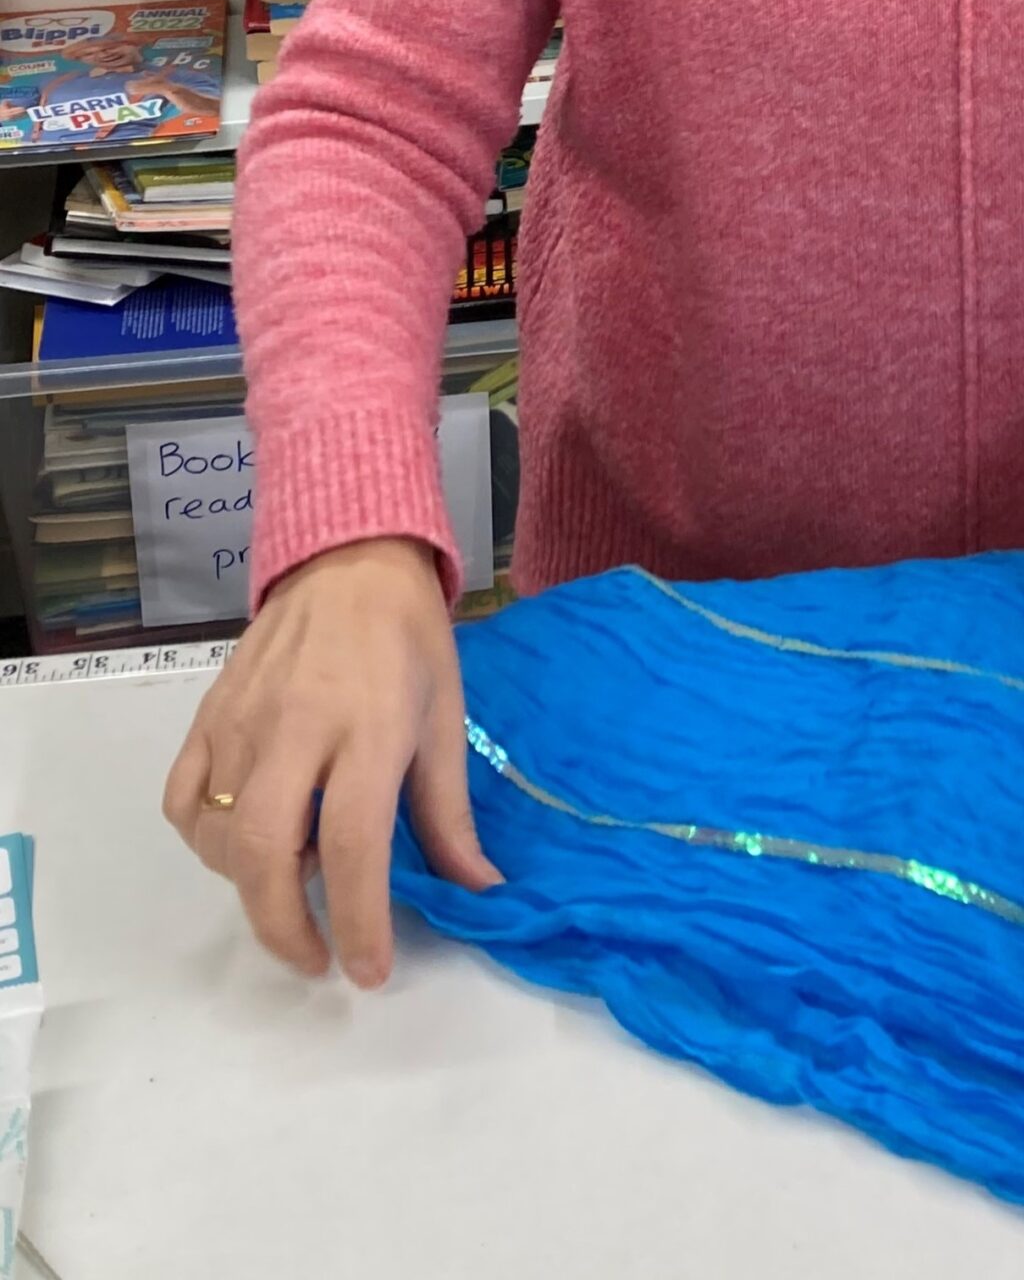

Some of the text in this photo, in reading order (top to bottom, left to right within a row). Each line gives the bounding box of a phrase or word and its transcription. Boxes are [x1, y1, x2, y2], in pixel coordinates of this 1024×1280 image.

[136, 8, 205, 18] ANNUAL
[131, 18, 201, 30] 2022
[1, 26, 100, 42] Blippi
[33, 95, 125, 120] LEARN
[70, 99, 162, 129] PLAY
